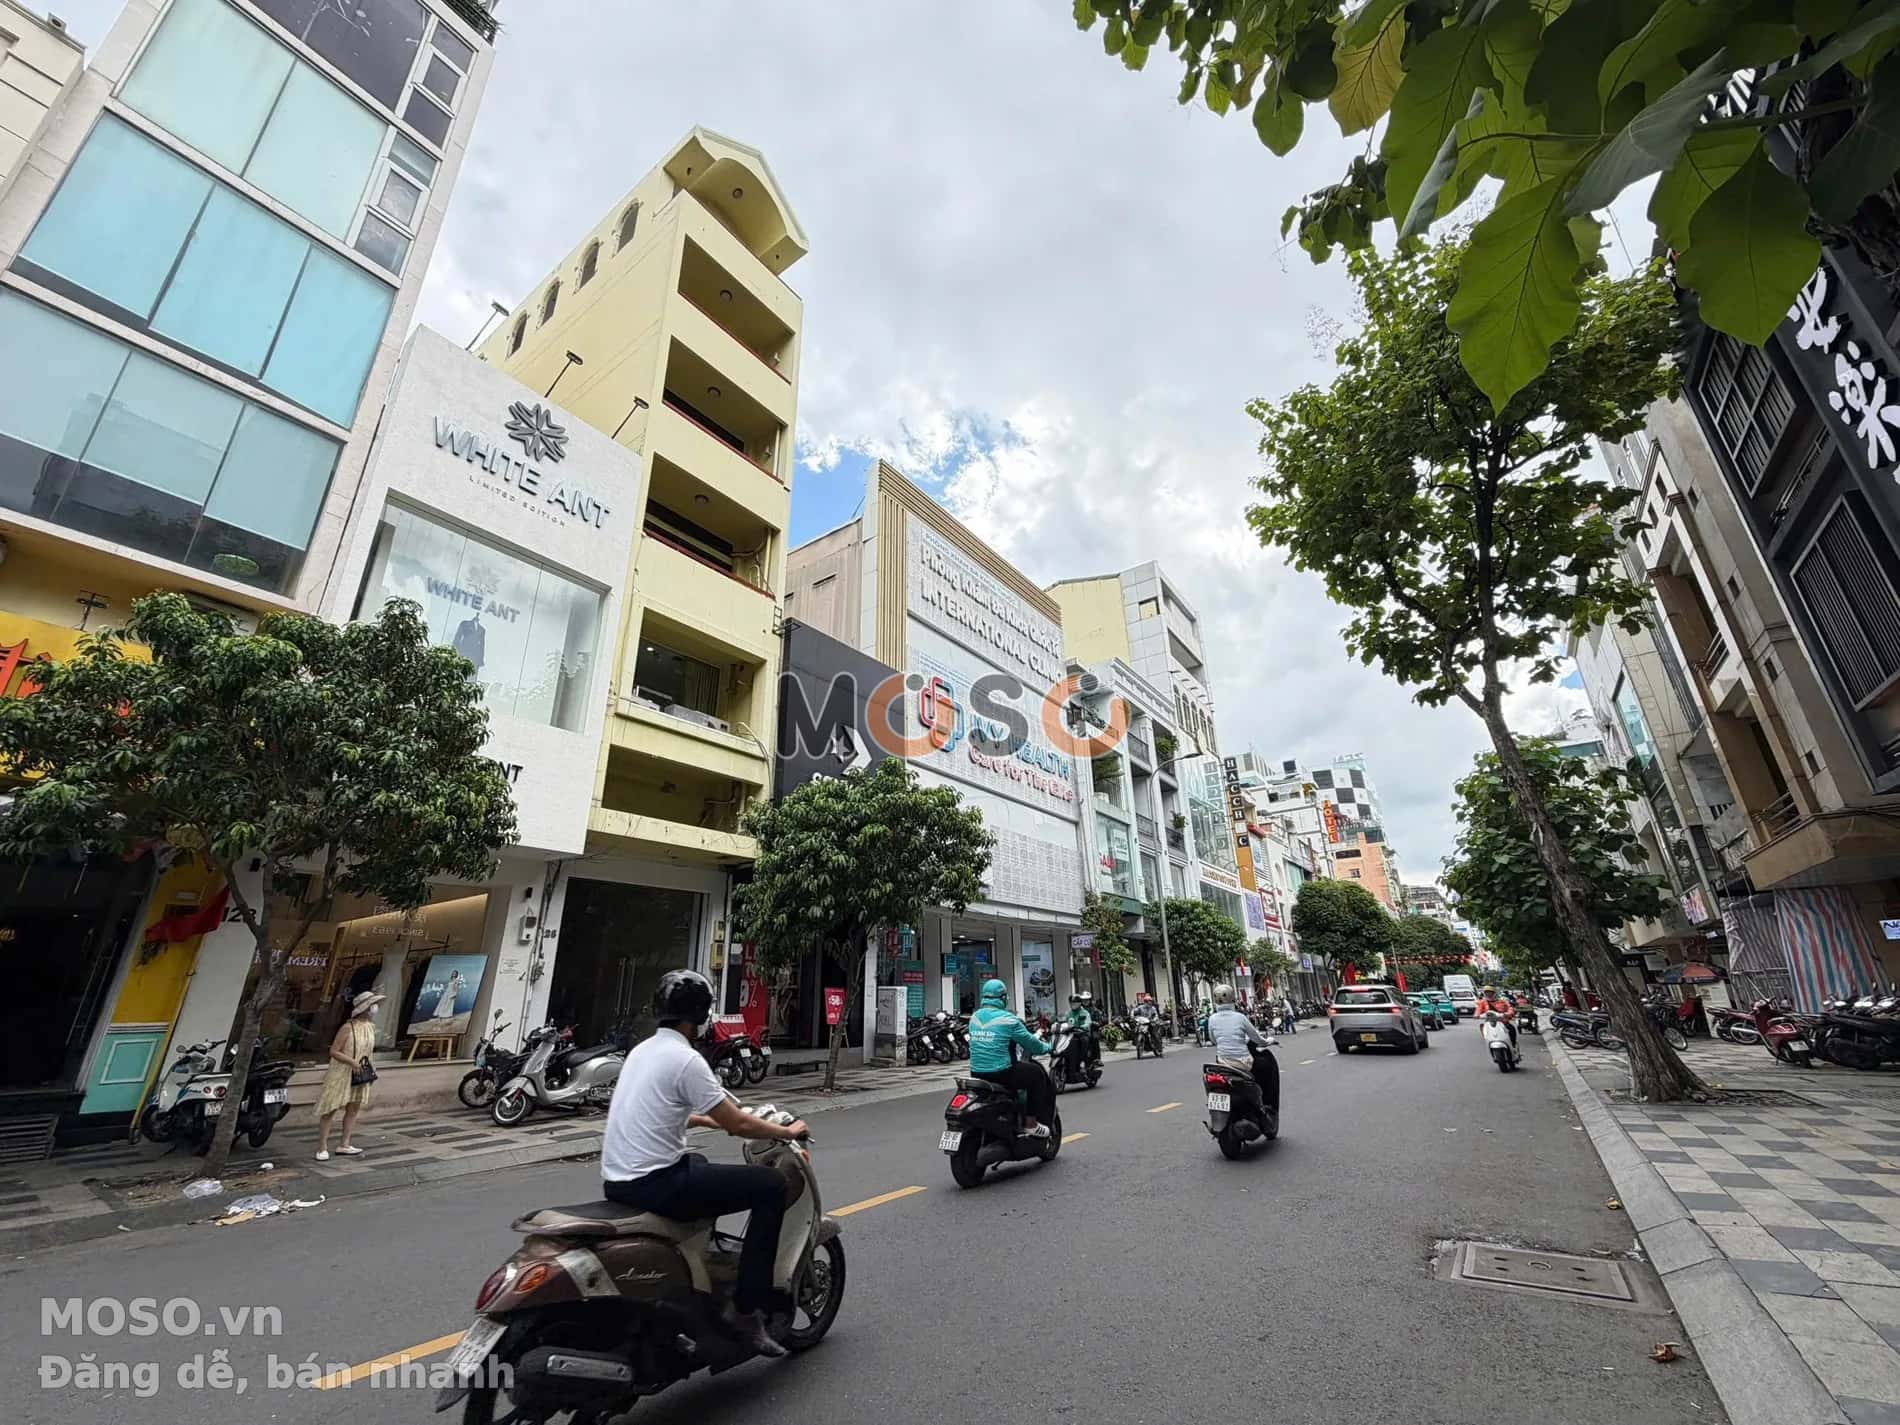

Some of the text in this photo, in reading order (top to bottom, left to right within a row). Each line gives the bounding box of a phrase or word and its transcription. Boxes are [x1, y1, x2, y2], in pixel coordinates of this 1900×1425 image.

[433, 415, 611, 529] WHITE ANT
[469, 475, 566, 528] LIMITED EDITION
[425, 576, 521, 624] WHITE ANT
[921, 577, 1026, 665] INTERNATIONAL
[499, 761, 524, 784] NT
[1323, 800, 1338, 843] HOTEL
